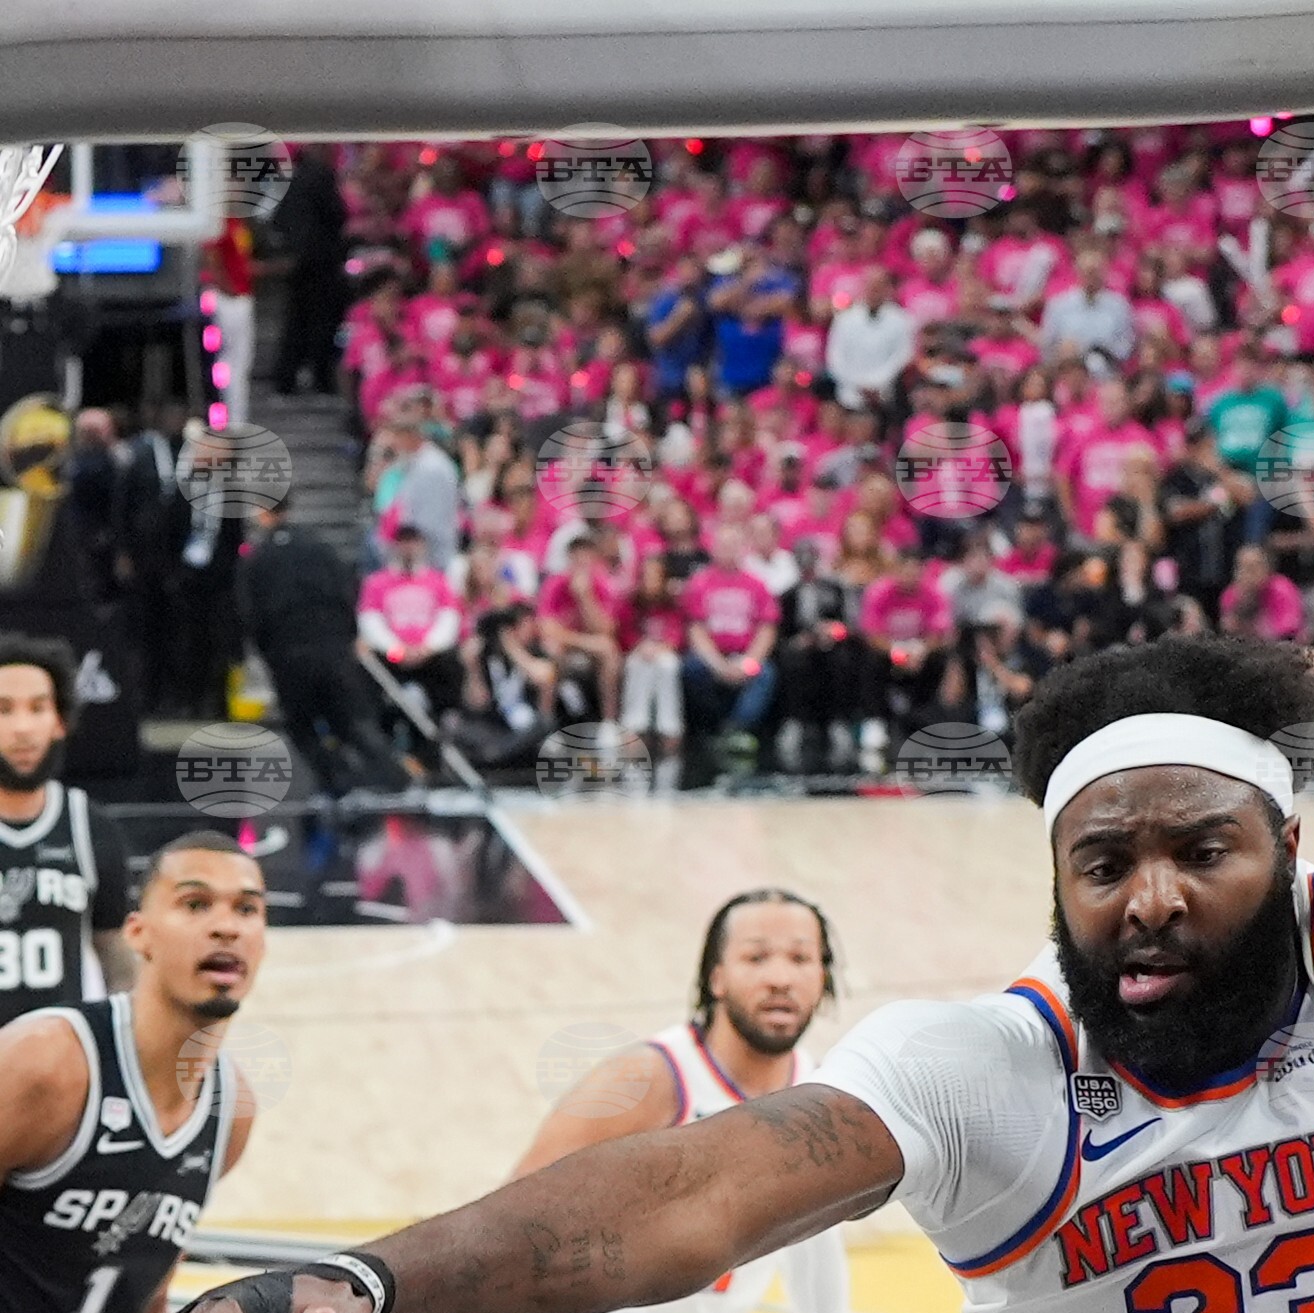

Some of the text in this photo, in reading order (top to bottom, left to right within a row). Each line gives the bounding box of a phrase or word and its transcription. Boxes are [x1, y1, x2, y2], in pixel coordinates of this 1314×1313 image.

[1077, 1079, 1113, 1090] USA
[1078, 1097, 1118, 1110] 250
[1053, 1162, 1213, 1289] NEW
